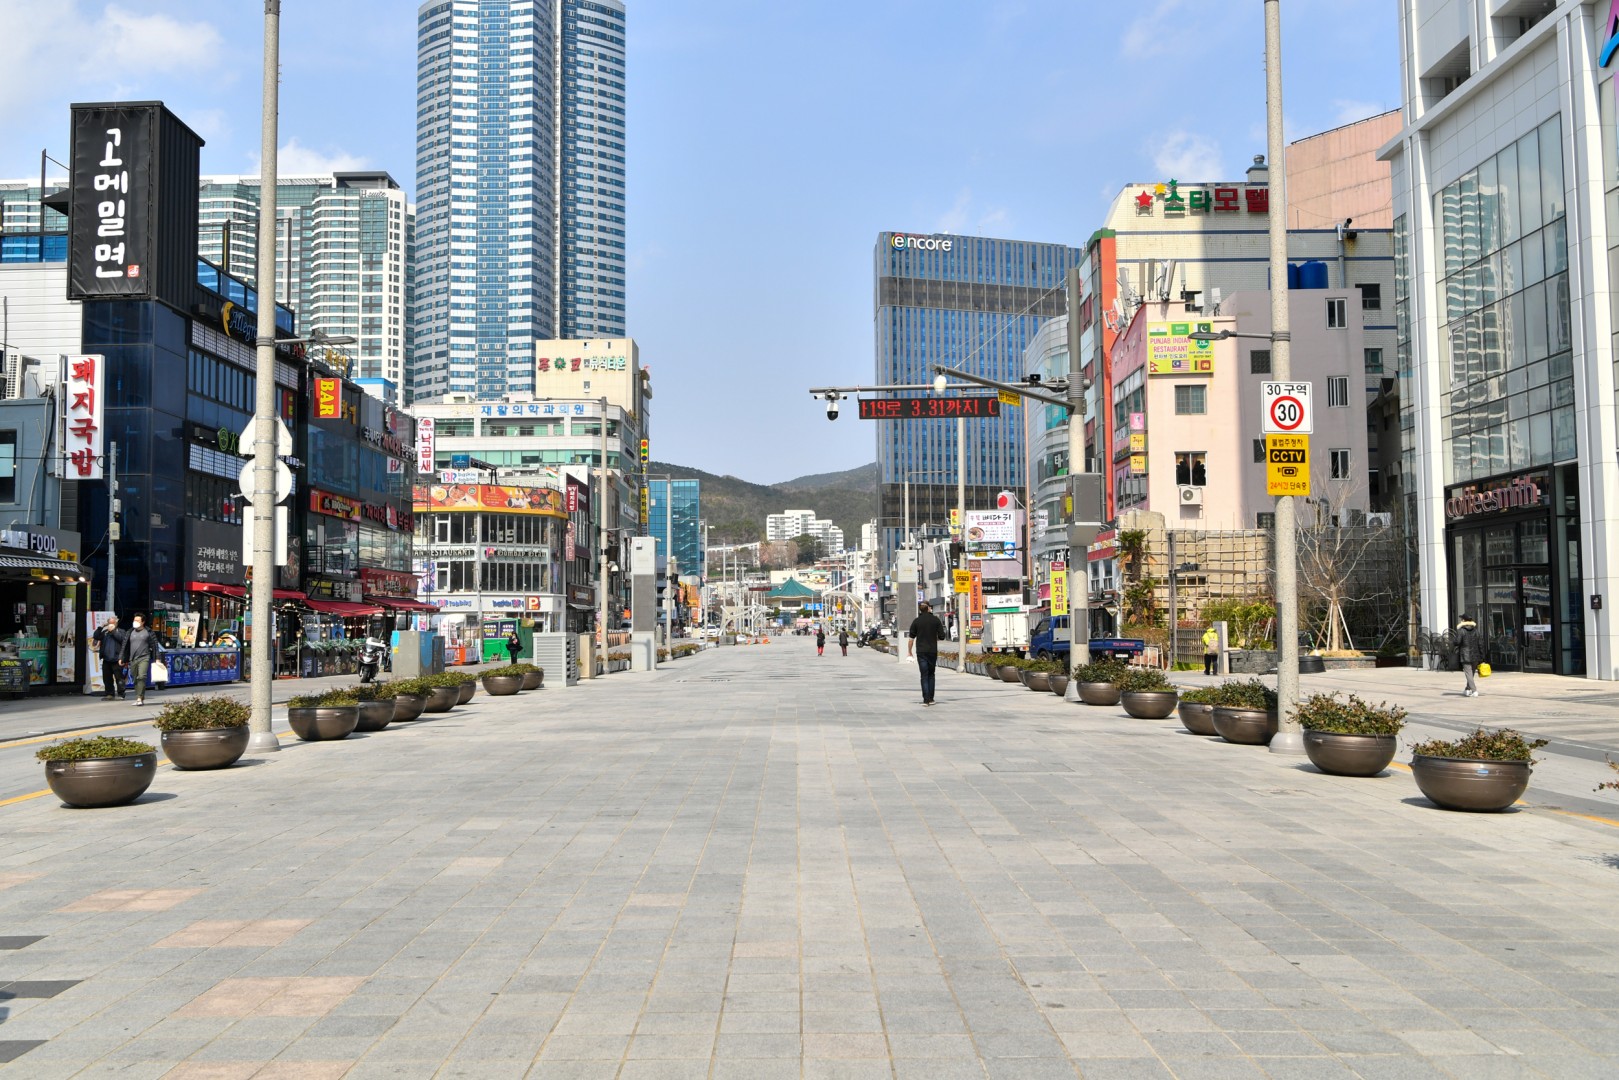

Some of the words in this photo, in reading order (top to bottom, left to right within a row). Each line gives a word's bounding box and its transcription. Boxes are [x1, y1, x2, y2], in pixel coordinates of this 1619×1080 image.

[94, 128, 128, 278] 고메밀면
[894, 235, 952, 251] encore
[319, 379, 335, 416] BAR
[1267, 384, 1281, 396] 30
[1284, 384, 1307, 396] 구역
[69, 357, 98, 476] 돼지국밥
[481, 404, 585, 417] 재활의학과의원
[911, 399, 979, 417] 3.31까지
[1278, 404, 1297, 422] 30
[420, 433, 433, 472] 낙곱새
[1272, 450, 1303, 462] CCTV
[1270, 481, 1289, 490] 24시간
[1446, 474, 1538, 518] coffeesmith
[30, 533, 57, 552] FOOD
[528, 597, 539, 609] P
[1054, 577, 1064, 611] 돼지갈비
